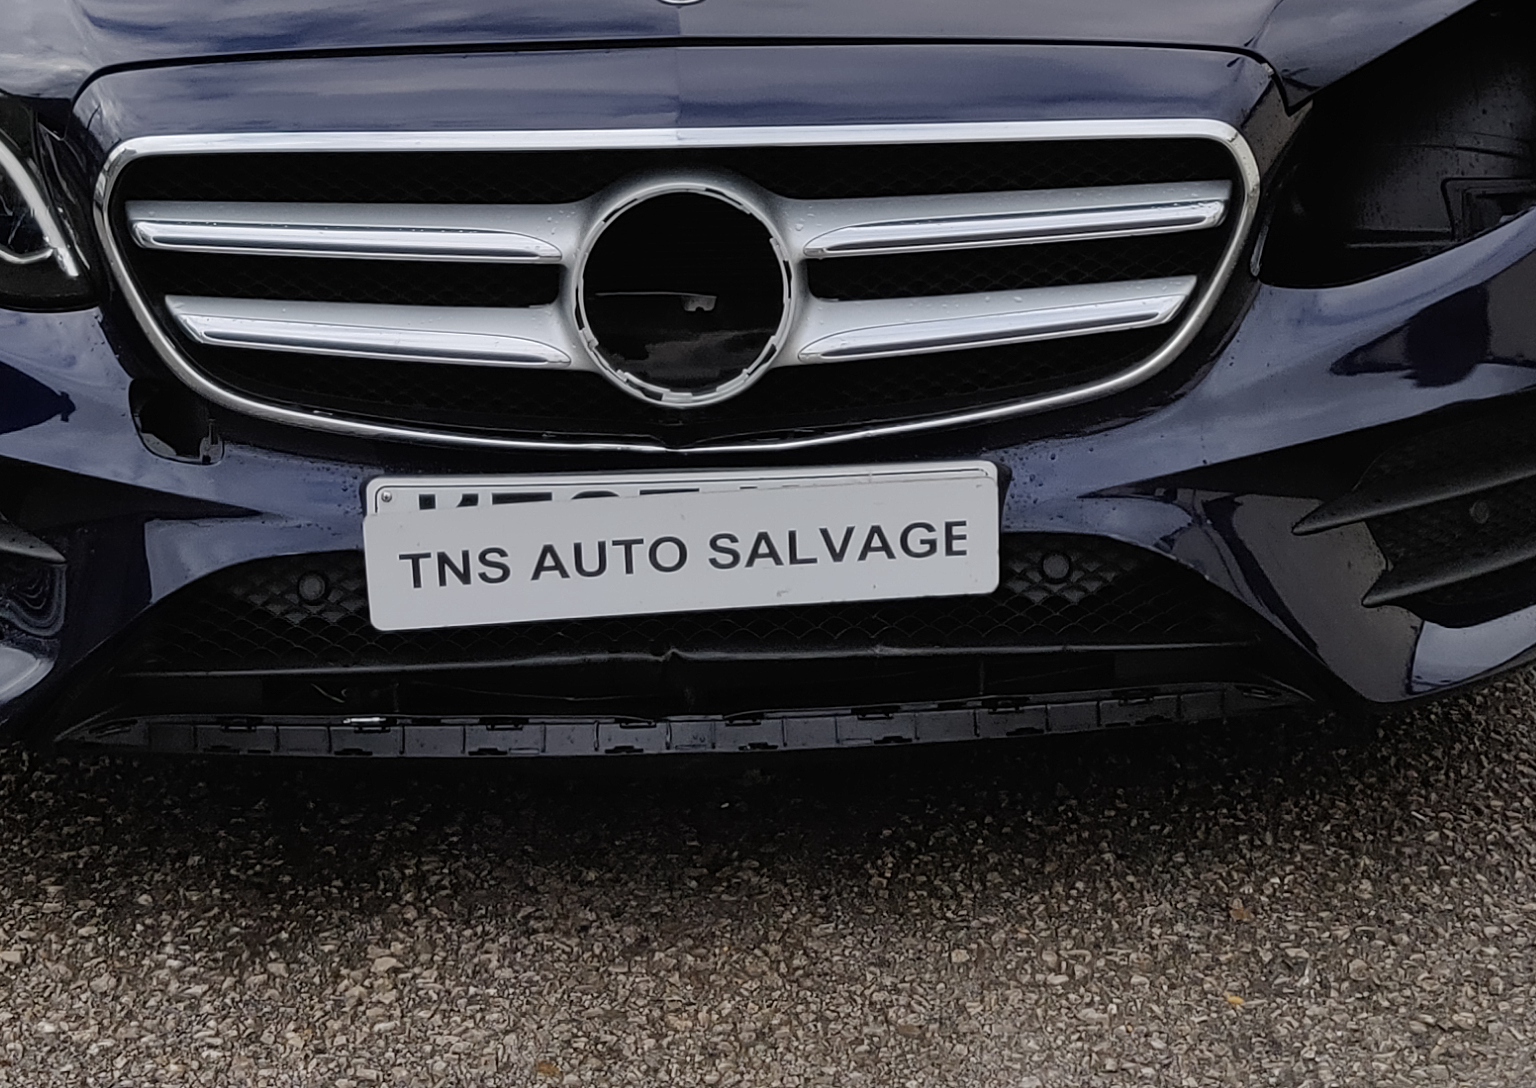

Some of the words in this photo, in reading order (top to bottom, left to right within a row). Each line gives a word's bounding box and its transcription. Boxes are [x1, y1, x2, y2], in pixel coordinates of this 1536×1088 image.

[399, 547, 511, 589] TNS
[530, 536, 688, 581] AUTO
[707, 520, 968, 570] SALVAGE
